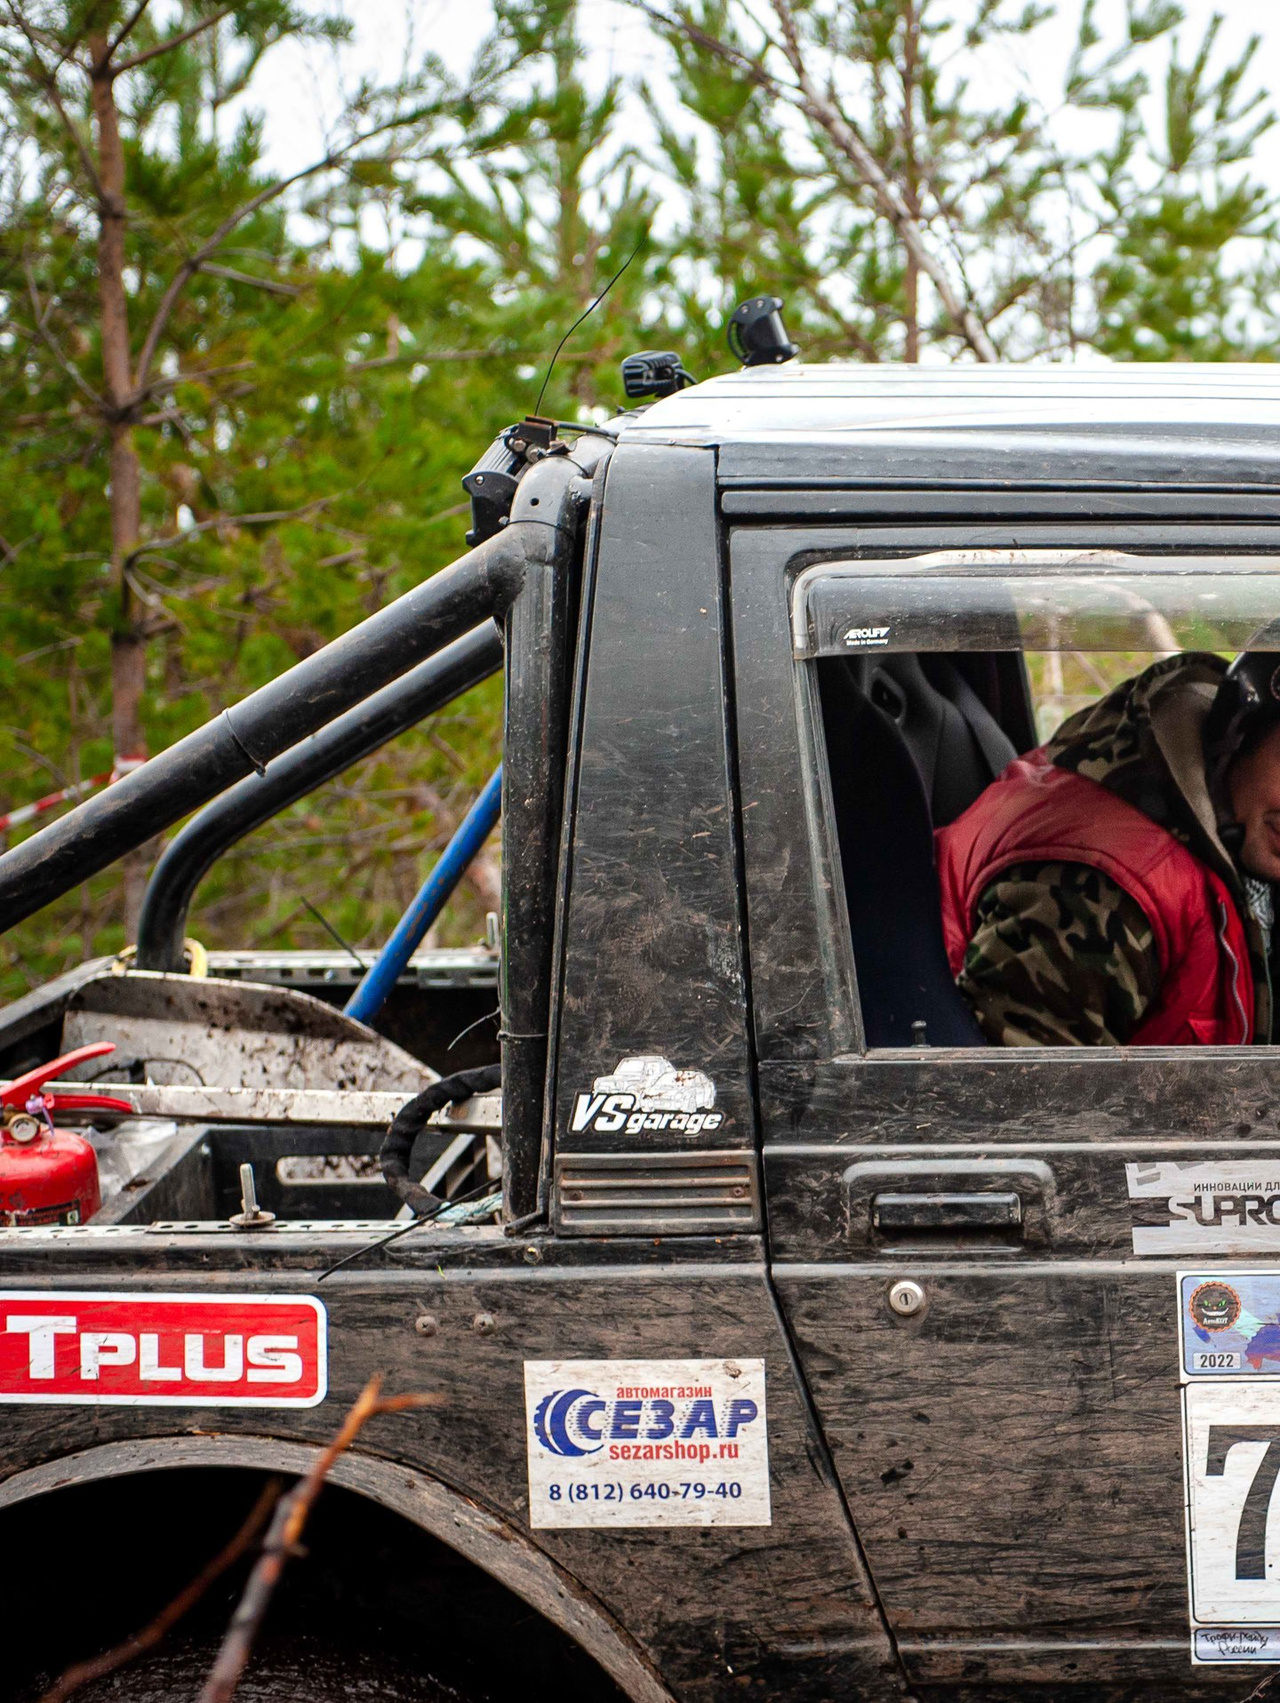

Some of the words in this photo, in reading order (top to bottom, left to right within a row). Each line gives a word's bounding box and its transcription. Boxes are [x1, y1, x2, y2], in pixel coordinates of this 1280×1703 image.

[1193, 1182, 1263, 1192] ИННОВАЦИИ
[6, 1315, 303, 1383] TPLUS
[1200, 1354, 1234, 1368] 2022
[616, 1386, 712, 1399] автомагазин
[609, 1440, 739, 1463] sezarshop.ru
[549, 1484, 562, 1501] 8
[568, 1483, 624, 1502] (812)
[630, 1482, 742, 1500] 640-79-40
